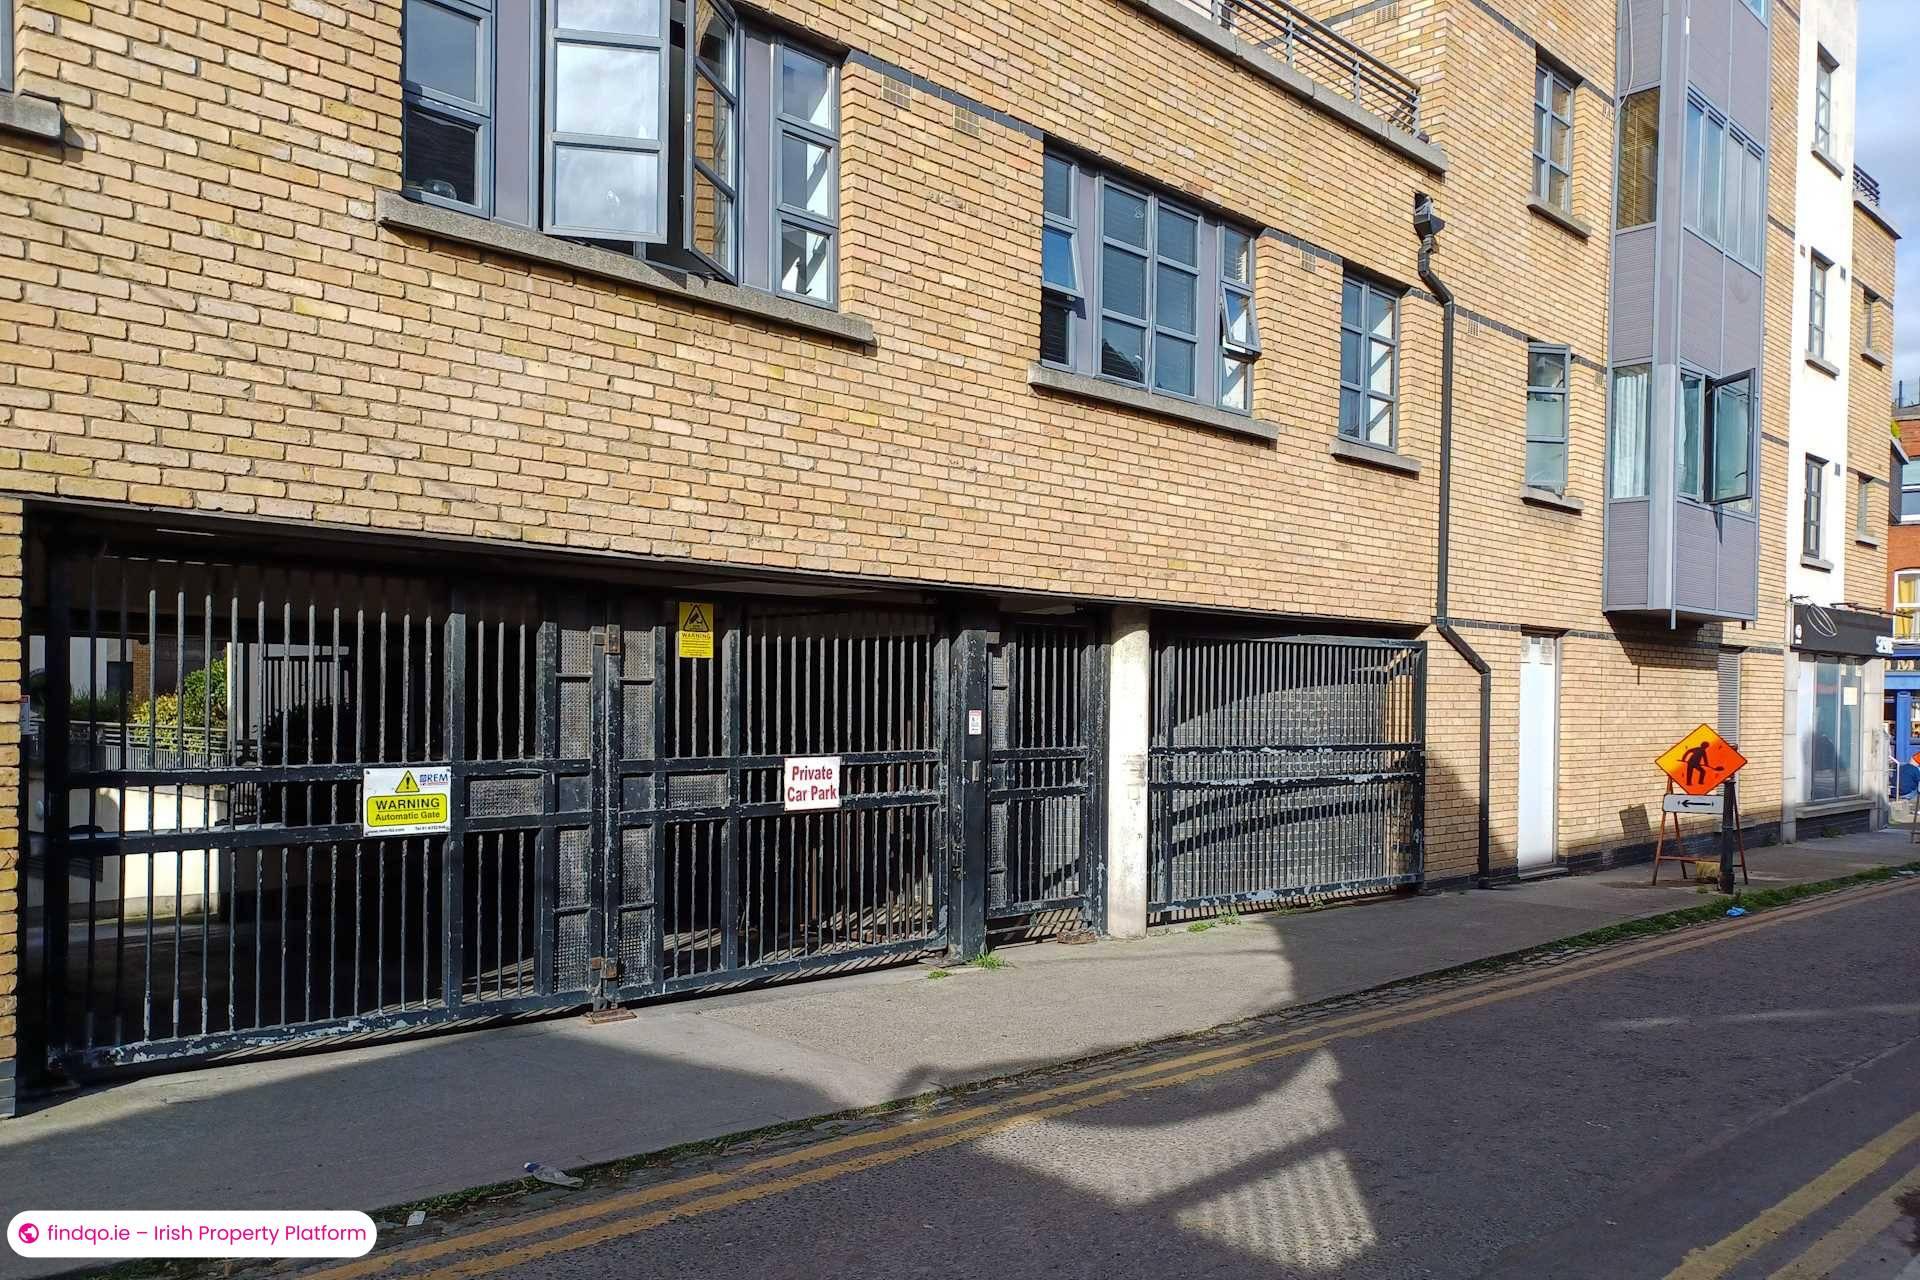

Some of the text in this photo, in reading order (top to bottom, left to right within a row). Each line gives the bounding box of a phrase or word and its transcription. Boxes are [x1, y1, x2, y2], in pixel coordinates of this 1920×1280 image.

[681, 632, 711, 640] WARNING
[427, 773, 448, 782] REM
[792, 765, 833, 781] Private
[788, 784, 837, 802] Car Park
[376, 798, 440, 810] WARNING
[375, 811, 440, 821] Automatic Gate
